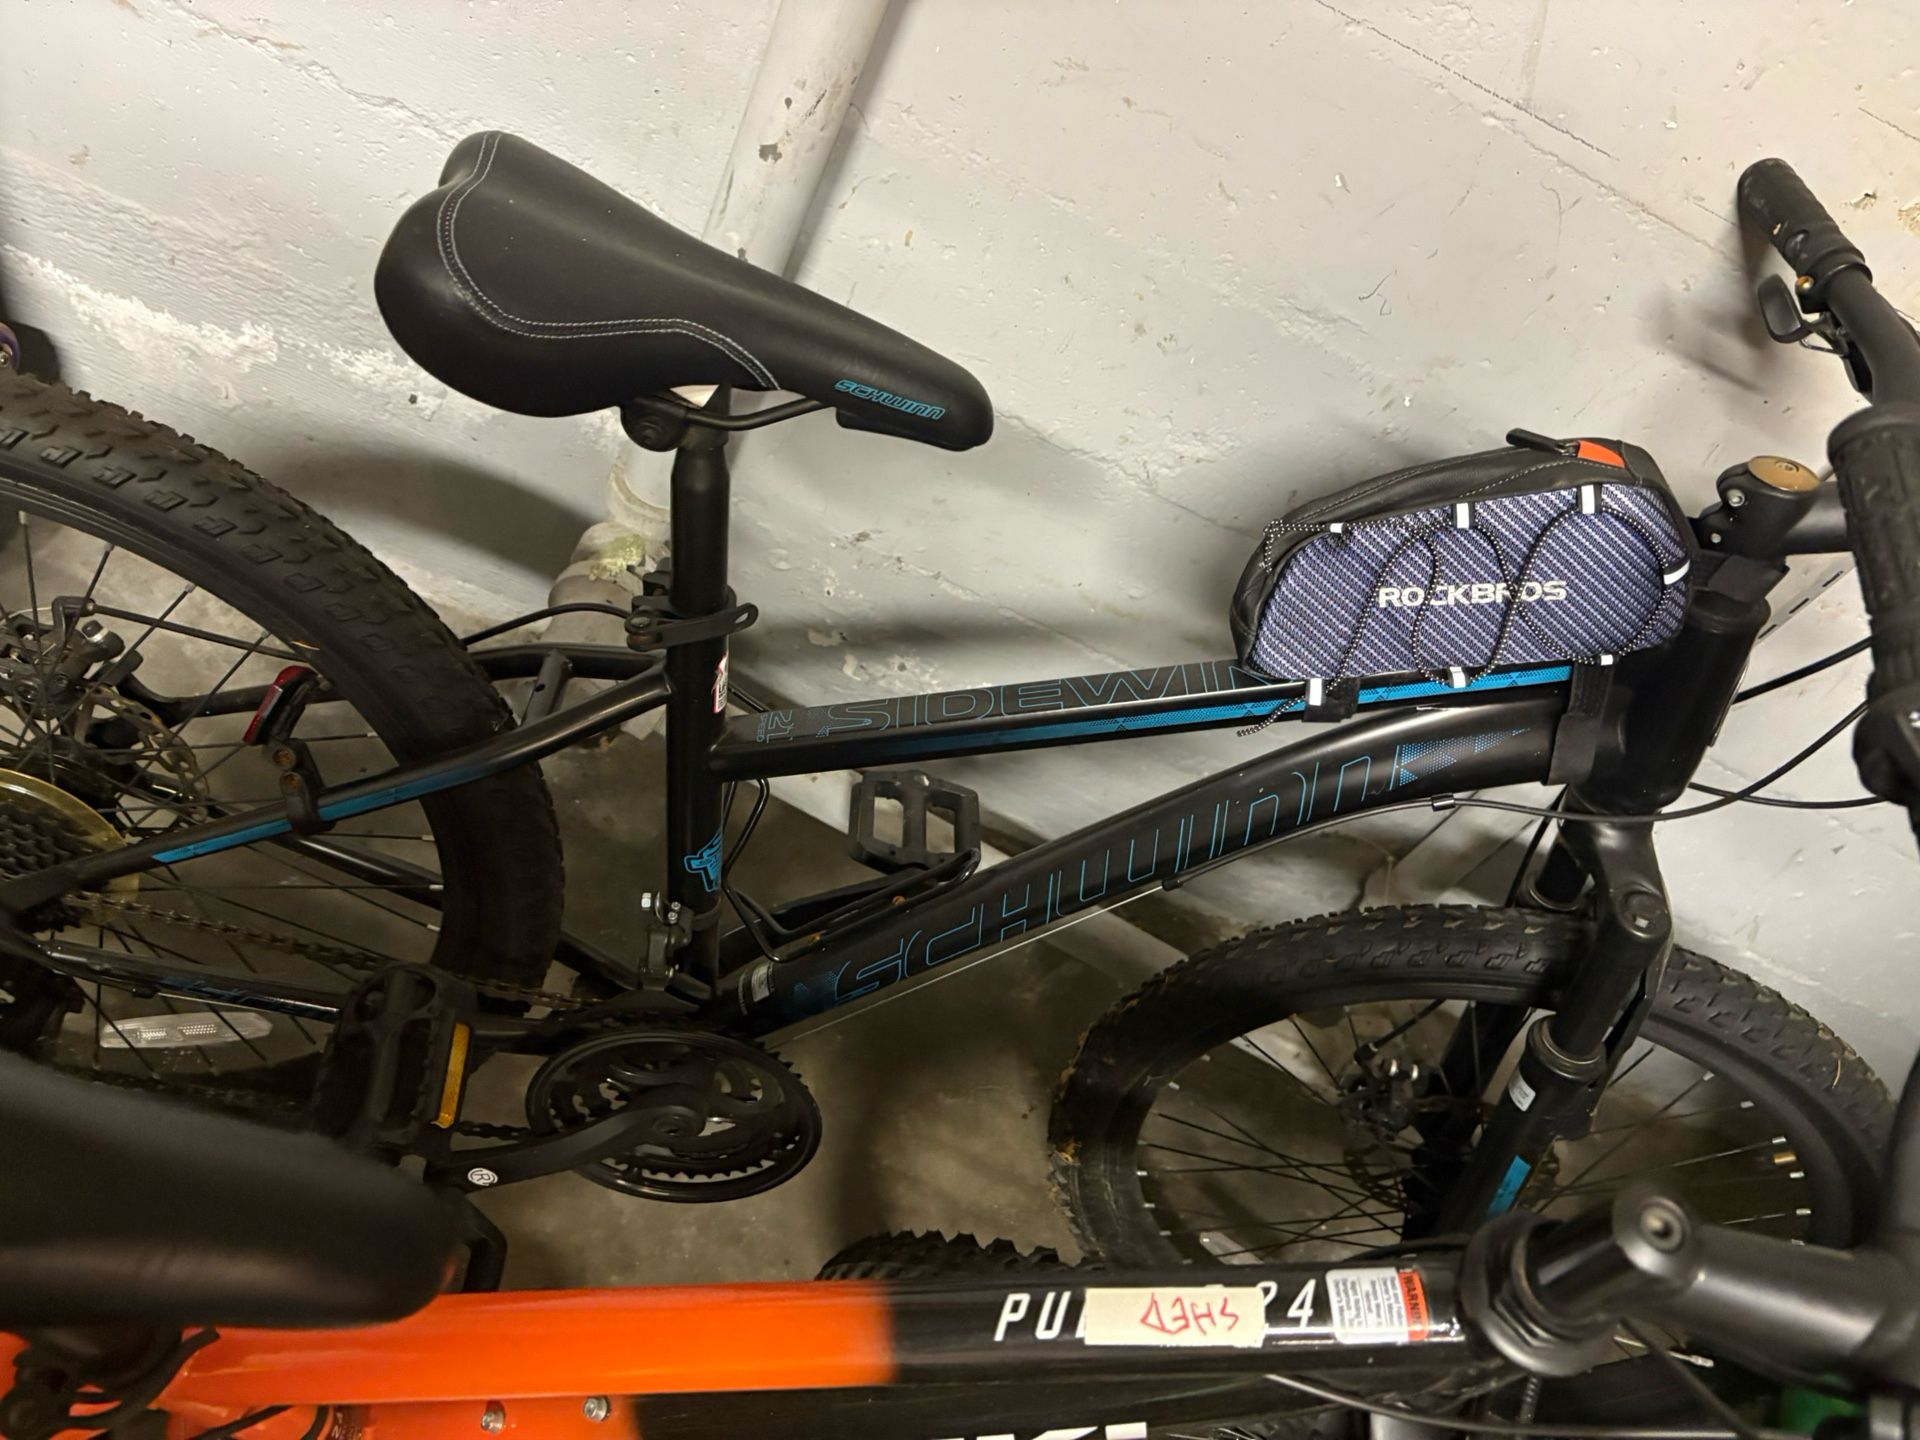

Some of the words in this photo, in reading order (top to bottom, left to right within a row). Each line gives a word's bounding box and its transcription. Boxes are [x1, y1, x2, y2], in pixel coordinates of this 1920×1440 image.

[834, 379, 946, 420] SCHWINN
[1378, 580, 1568, 608] ROCKBROS
[994, 1290, 1087, 1341] PU
[1403, 1275, 1422, 1326] WARNIN
